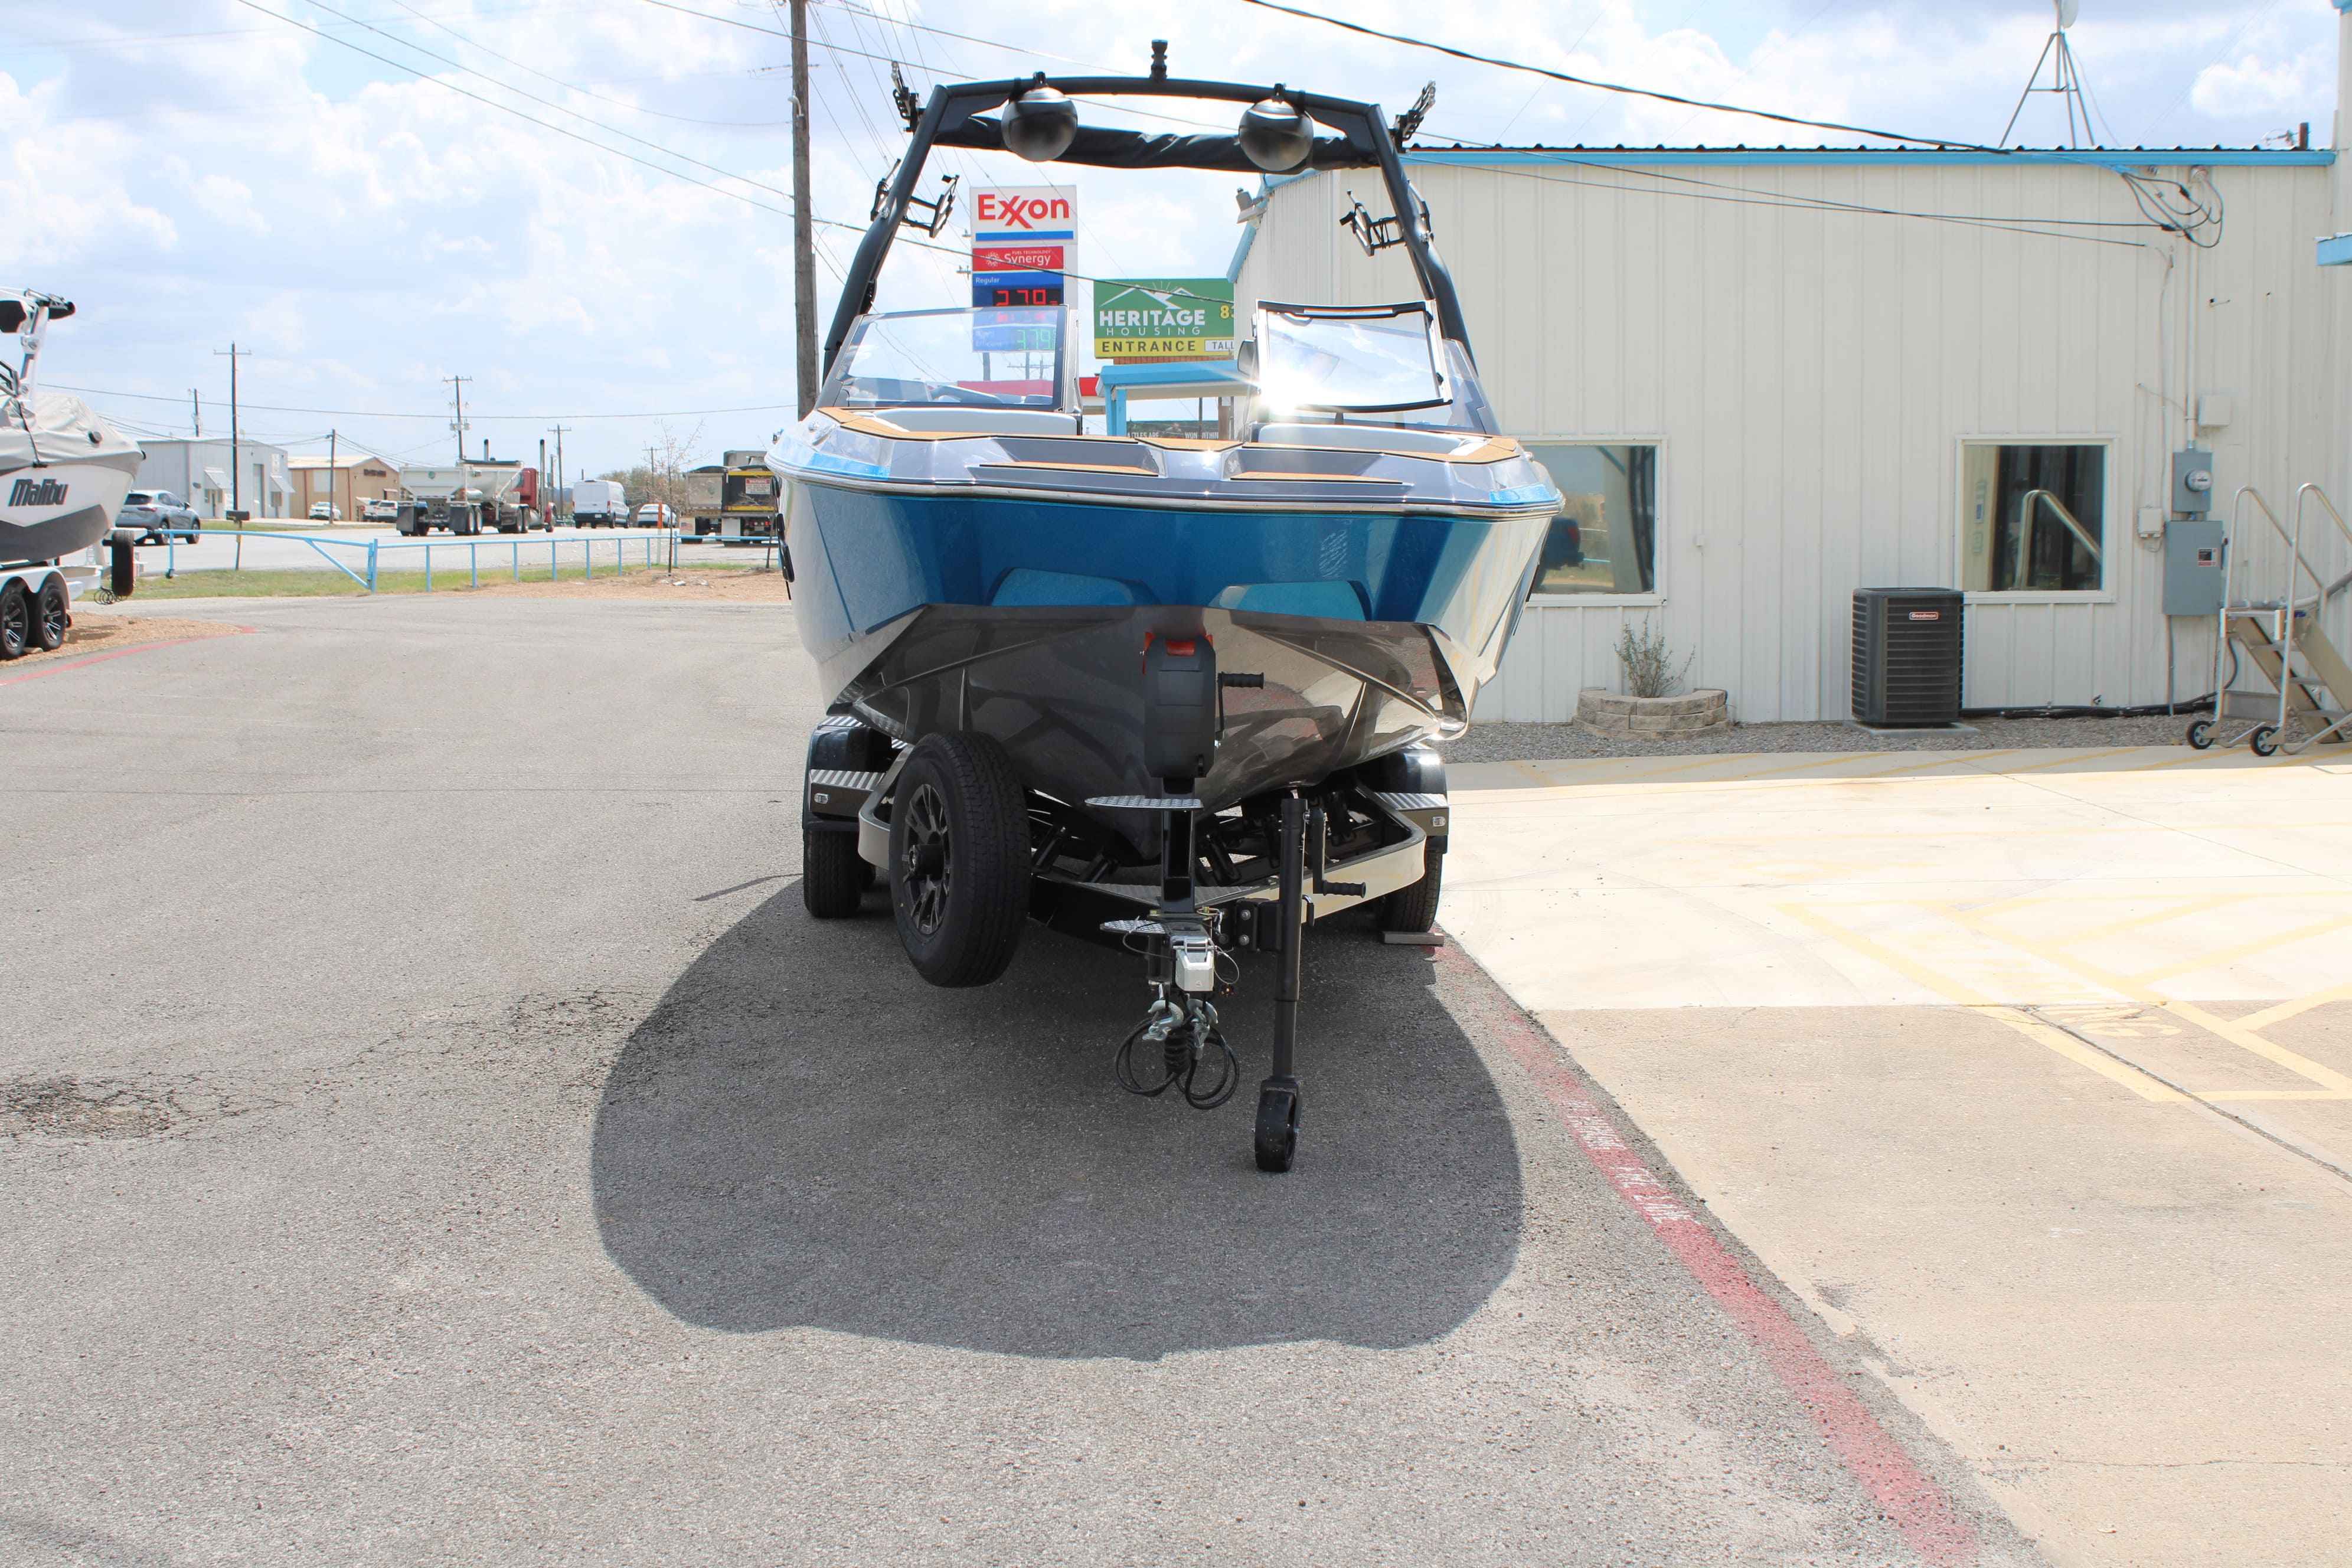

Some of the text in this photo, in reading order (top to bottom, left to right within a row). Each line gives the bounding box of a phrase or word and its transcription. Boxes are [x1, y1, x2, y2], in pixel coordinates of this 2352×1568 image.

[978, 194, 1070, 228] Exxon
[1004, 253, 1051, 266] Synergy
[975, 276, 1000, 285] Regular
[1099, 309, 1206, 326] HERITAGE
[1107, 326, 1200, 336] HOUSING
[1102, 341, 1195, 352] ENTRANCE
[1185, 432, 1198, 440] WON
[8, 479, 69, 507] Malibu
